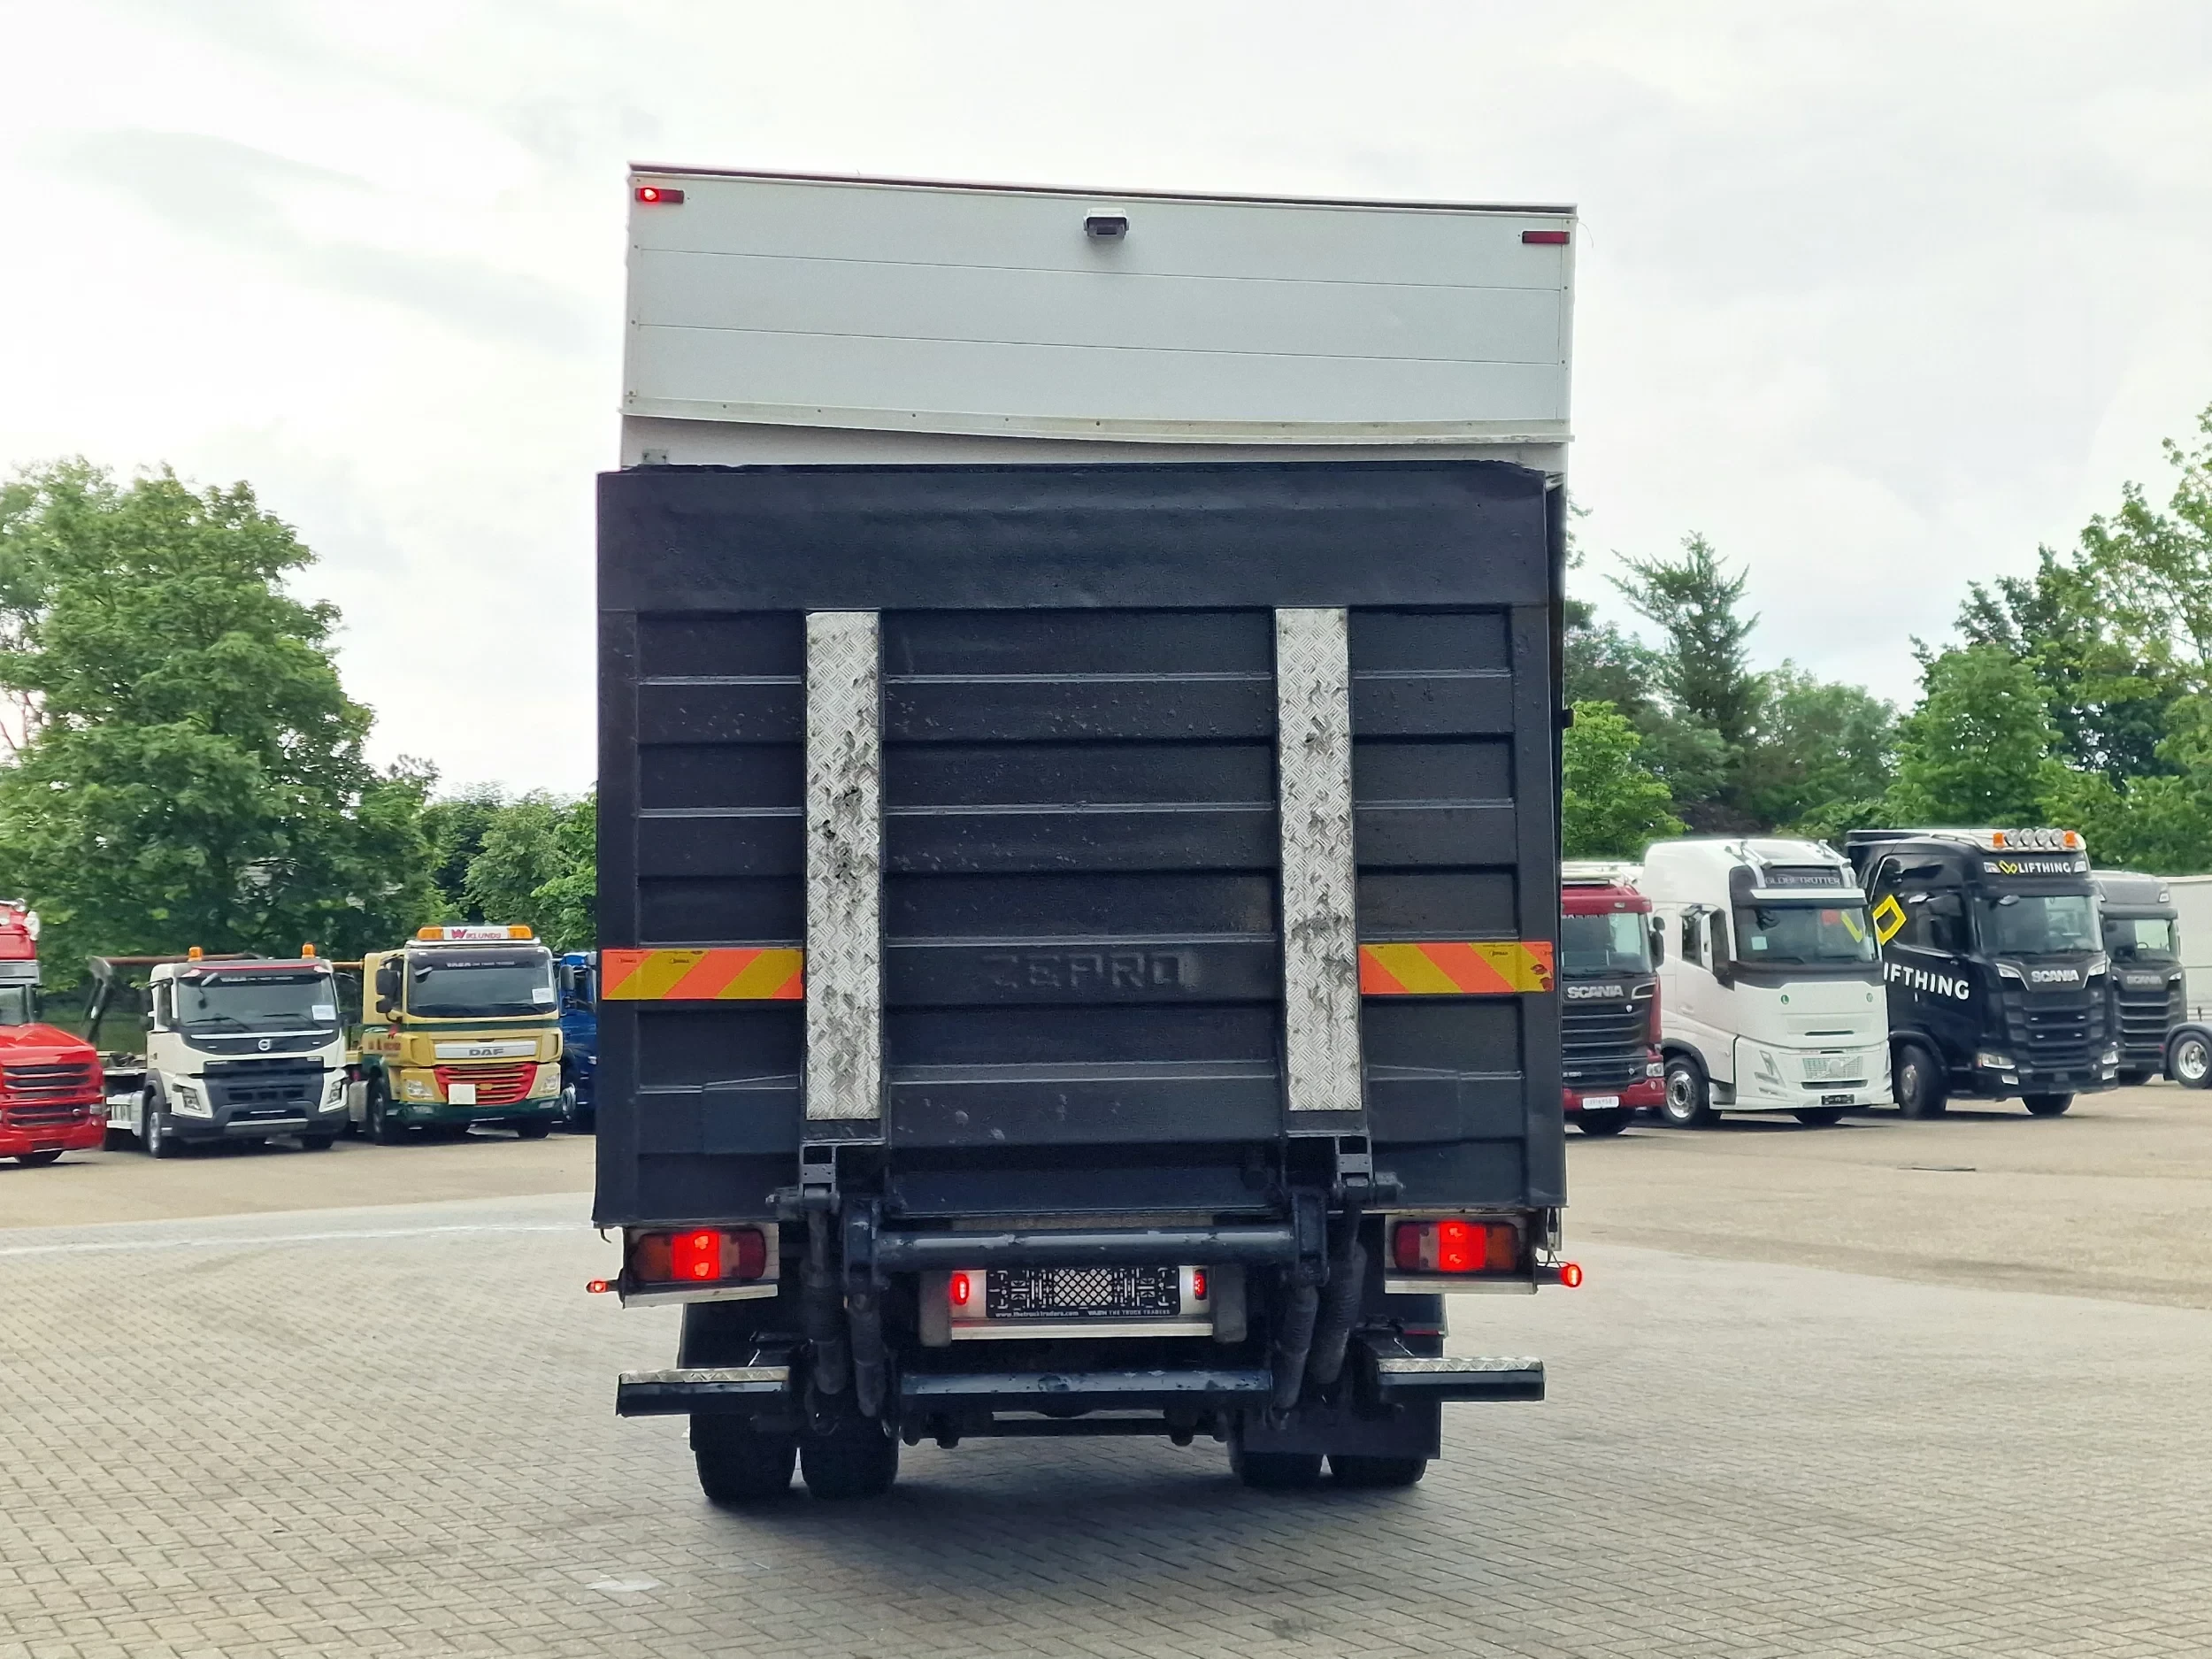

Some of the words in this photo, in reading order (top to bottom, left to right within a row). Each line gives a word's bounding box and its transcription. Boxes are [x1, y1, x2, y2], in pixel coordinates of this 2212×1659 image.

[2018, 862, 2070, 873] LIFTHING
[1765, 876, 1840, 885] GLOBETROTTER
[1883, 962, 1970, 1000] IFTHING
[2032, 970, 2079, 983] SCANIA
[2126, 975, 2162, 985] SCANIA
[1567, 985, 1624, 999] SCANIA
